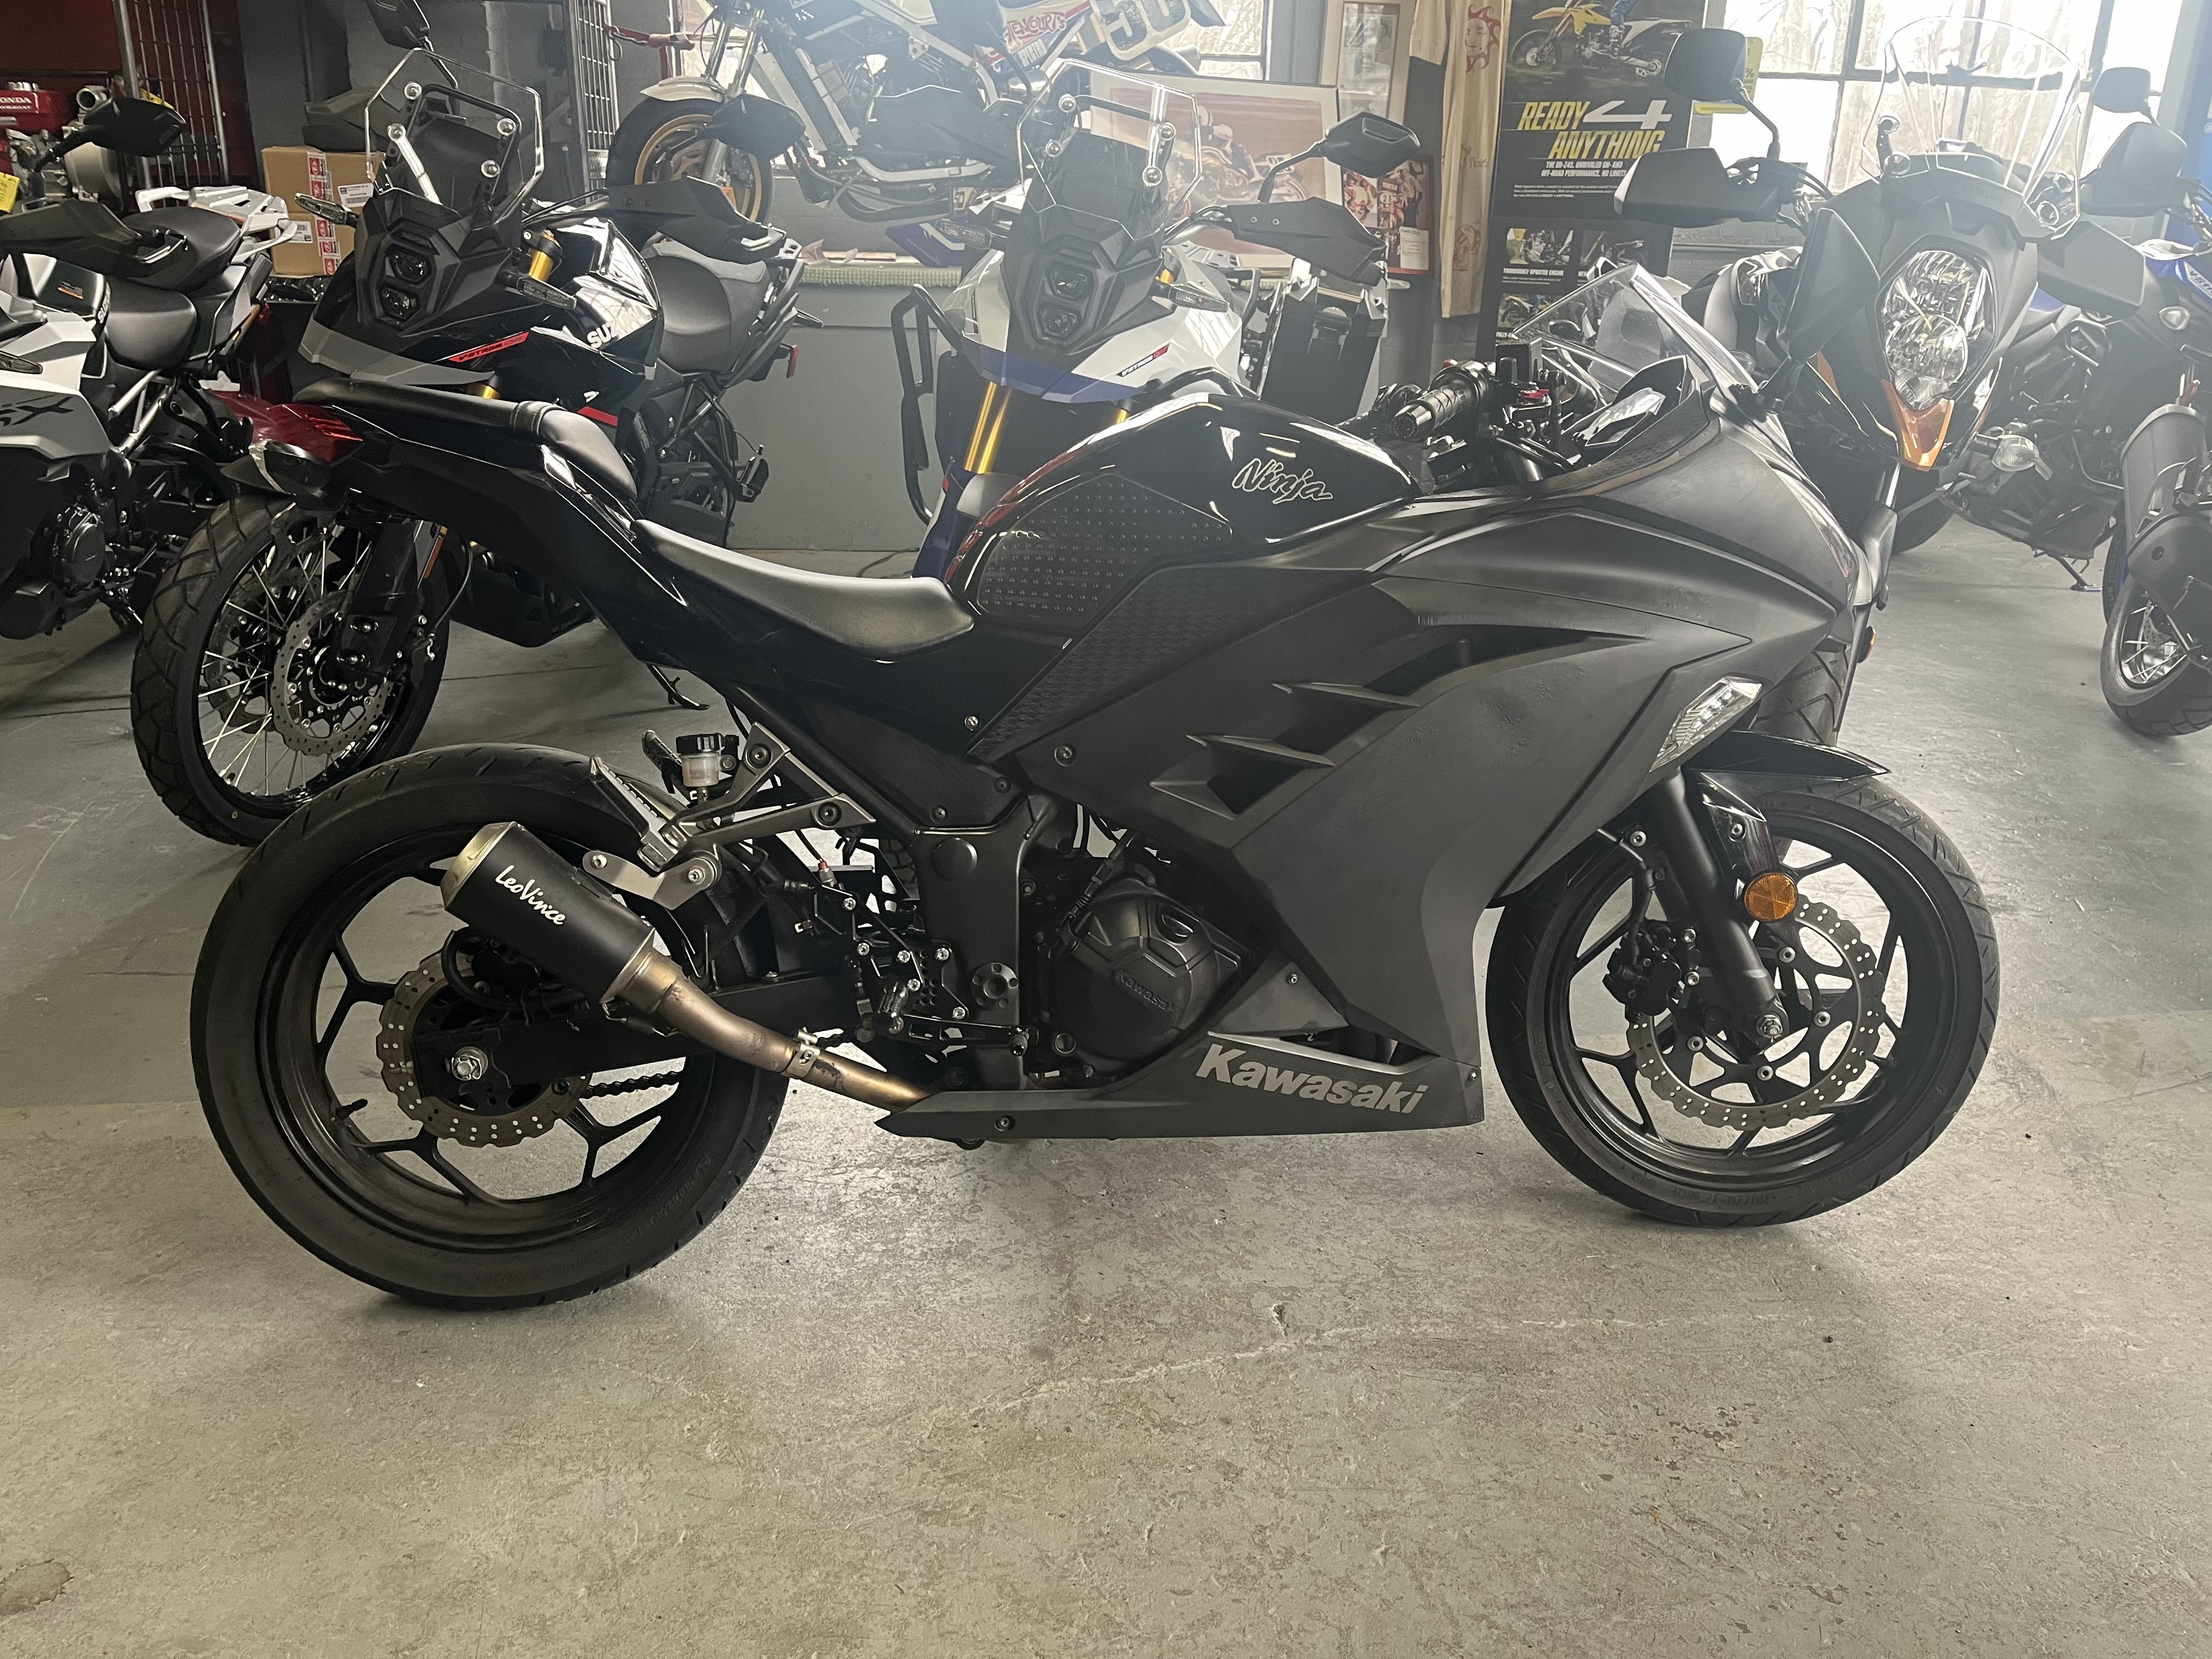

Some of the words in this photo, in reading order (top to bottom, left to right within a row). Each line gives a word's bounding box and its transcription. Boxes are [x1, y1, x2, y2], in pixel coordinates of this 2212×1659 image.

[1517, 101, 1590, 131] READY
[1583, 100, 1672, 130] 4
[1548, 130, 1666, 159] ANYTHING
[1232, 458, 1334, 505] Ninja
[495, 865, 566, 925] LeoVince
[1195, 1043, 1429, 1114] Kawasaki
